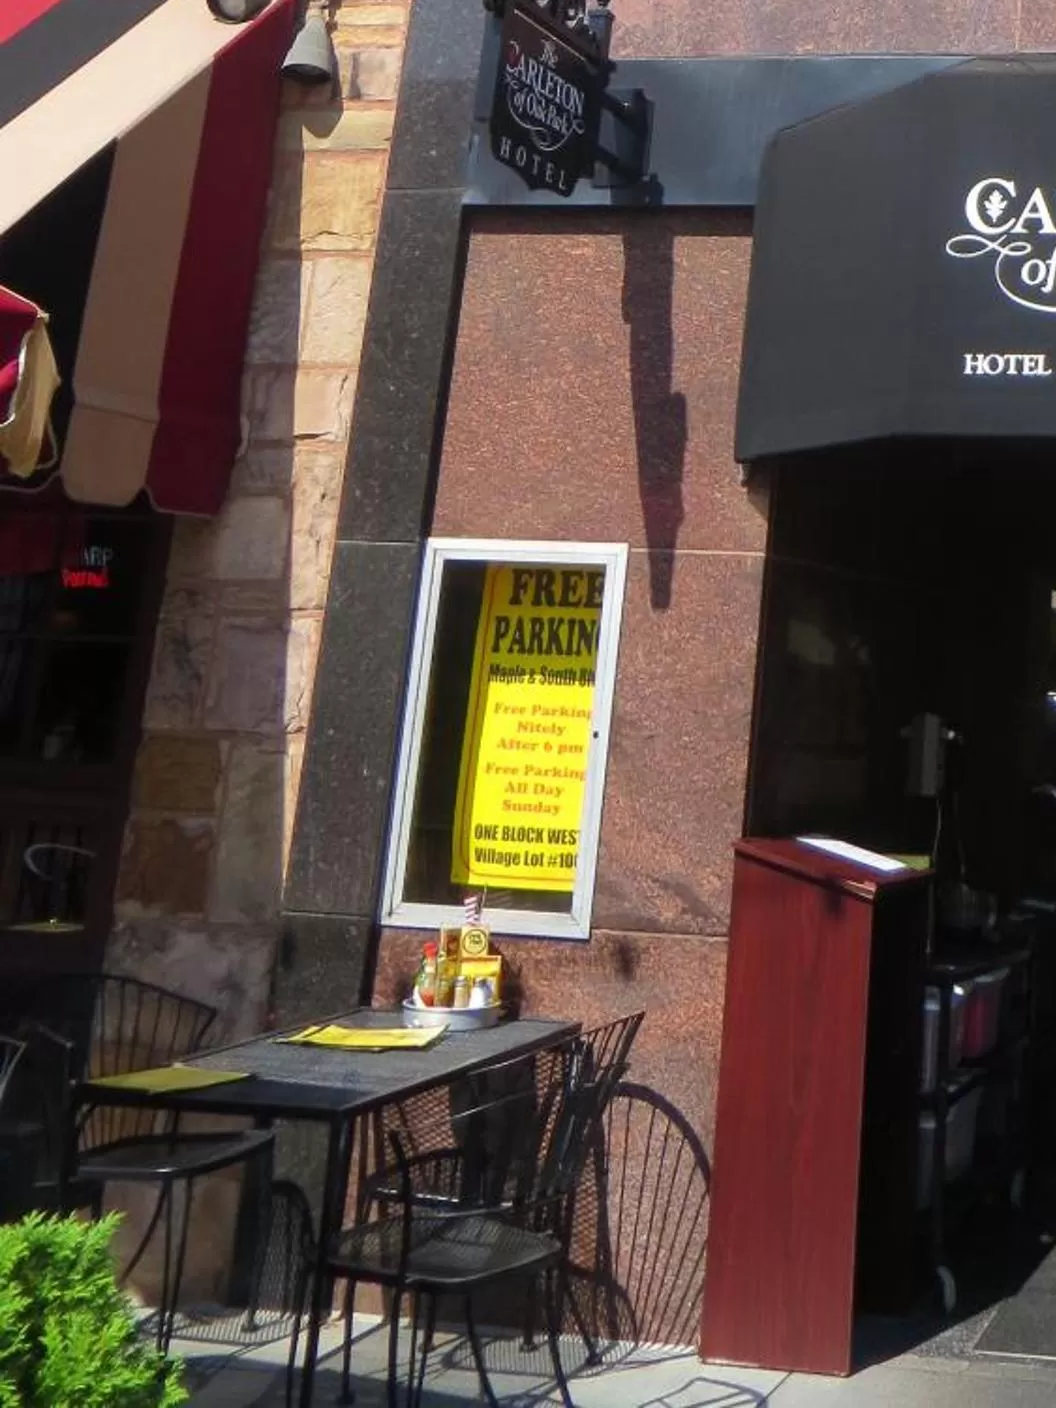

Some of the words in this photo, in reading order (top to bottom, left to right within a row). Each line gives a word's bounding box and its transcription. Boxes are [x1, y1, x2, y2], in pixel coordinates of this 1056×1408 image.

[540, 40, 558, 68] The
[506, 40, 585, 115] CARLETON
[514, 87, 529, 113] of
[527, 92, 546, 123] Oak
[547, 103, 569, 135] Park
[500, 136, 568, 190] HOTEL
[963, 353, 1052, 376] HOTEL
[509, 568, 604, 608] FREE
[492, 615, 601, 656] PARKIN
[488, 663, 526, 685] Maple
[527, 667, 537, 684] &
[538, 665, 577, 686] South
[494, 702, 526, 715] Free
[517, 721, 566, 736] Nitely
[497, 738, 540, 752] After
[543, 741, 552, 752] 6
[557, 743, 583, 755] pm
[486, 762, 519, 775] Free
[505, 780, 528, 794] All
[533, 783, 565, 797] Day
[502, 800, 561, 815] Sunday
[475, 823, 499, 841] ONE
[502, 825, 544, 843] BLOCK
[475, 847, 520, 867] Village
[524, 851, 544, 867] Lot
